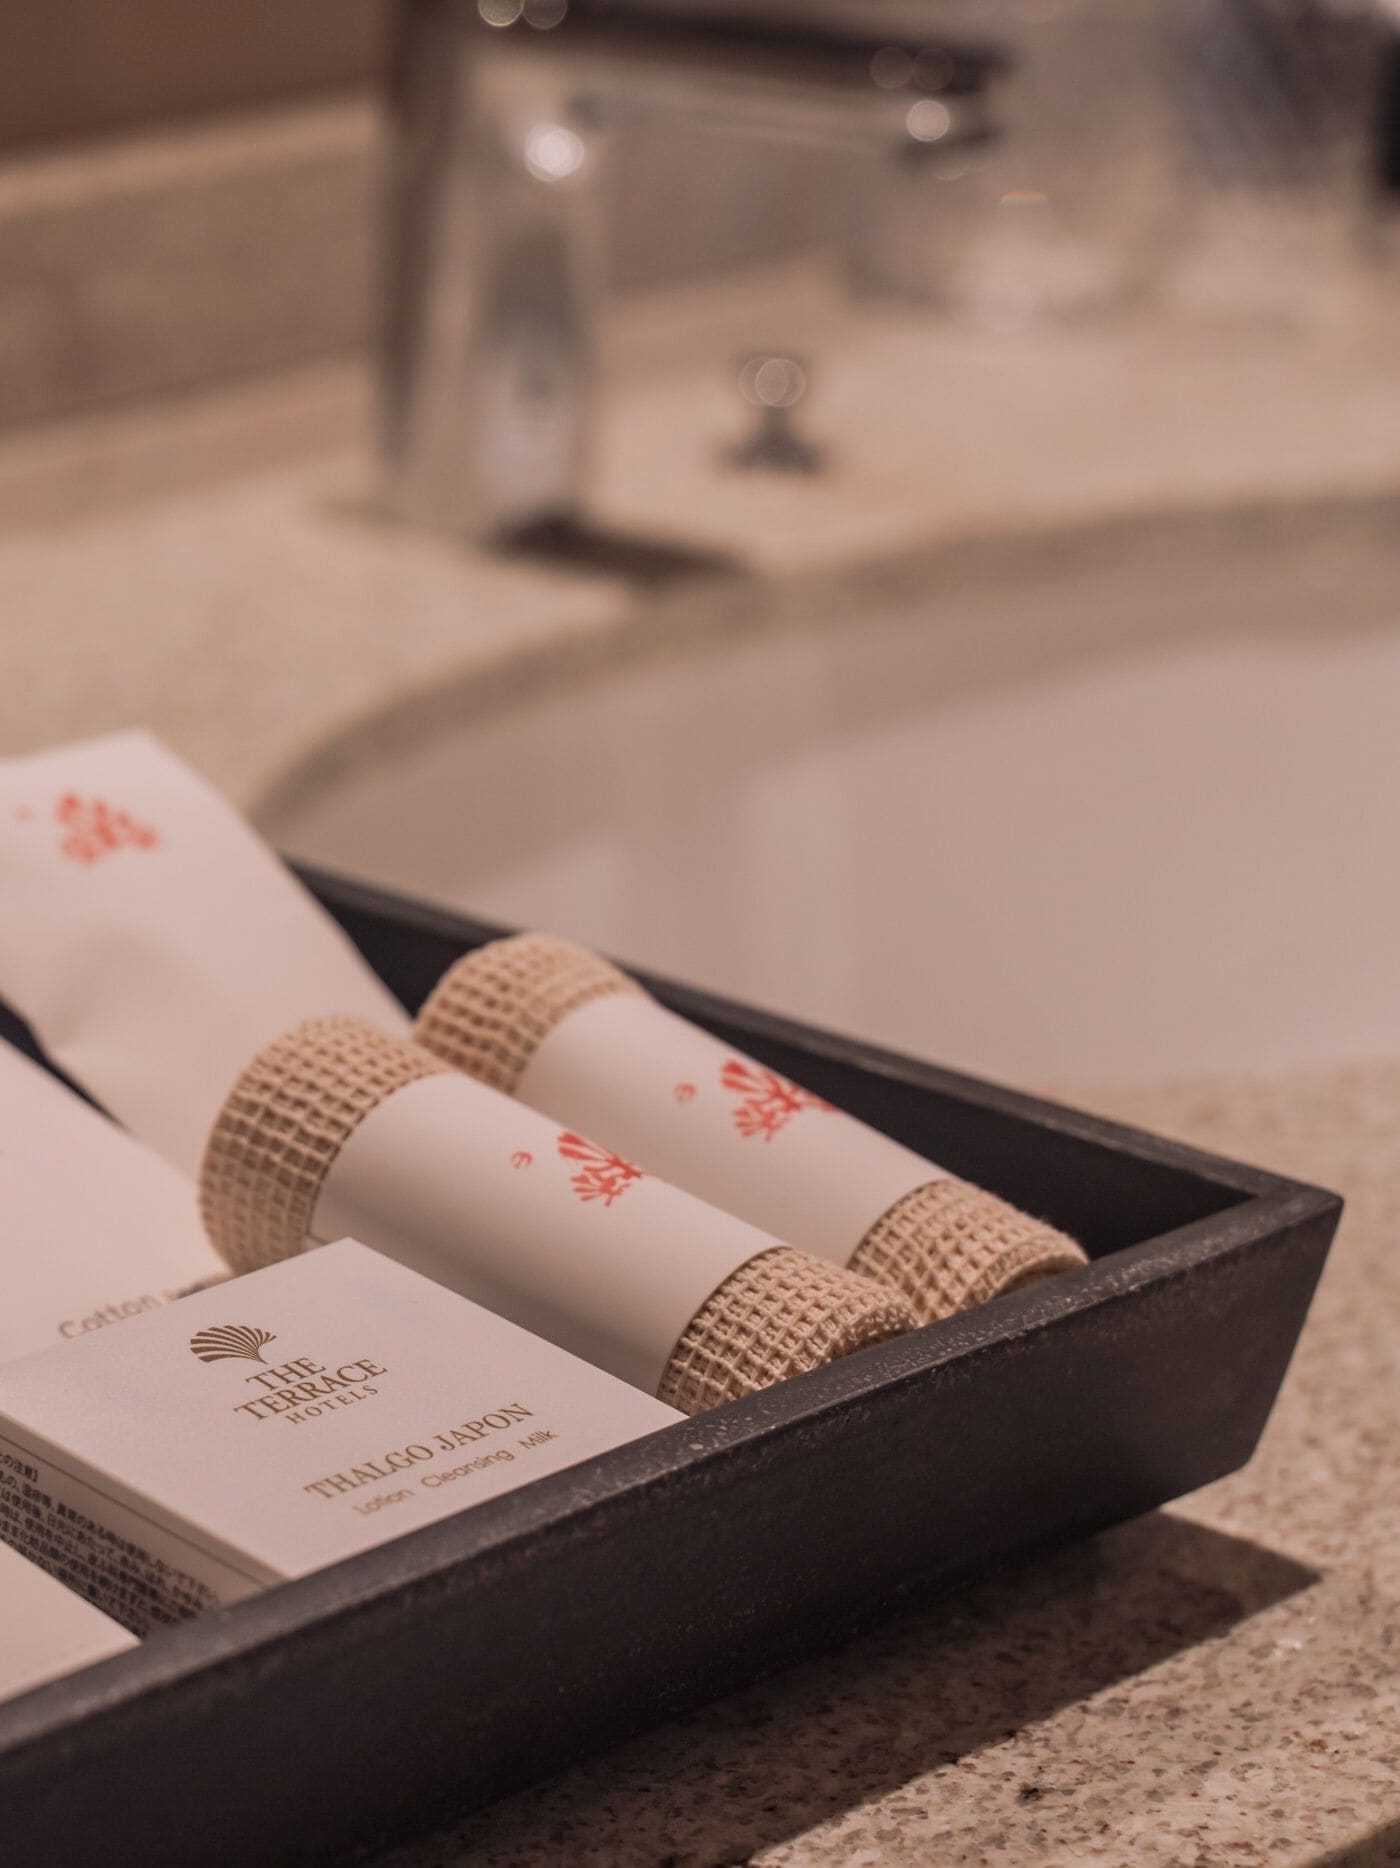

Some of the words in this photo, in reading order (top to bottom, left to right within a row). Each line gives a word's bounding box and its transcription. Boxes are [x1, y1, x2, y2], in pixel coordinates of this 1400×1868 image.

[233, 1359, 388, 1421] TERRACE
[245, 1357, 327, 1391] THE
[285, 1384, 378, 1424] HOTELS
[303, 1444, 434, 1499] THALGO
[432, 1402, 534, 1452] JAPON
[353, 1488, 415, 1515] Lotion
[421, 1449, 515, 1488] Cleansing
[518, 1429, 559, 1449] Milk
